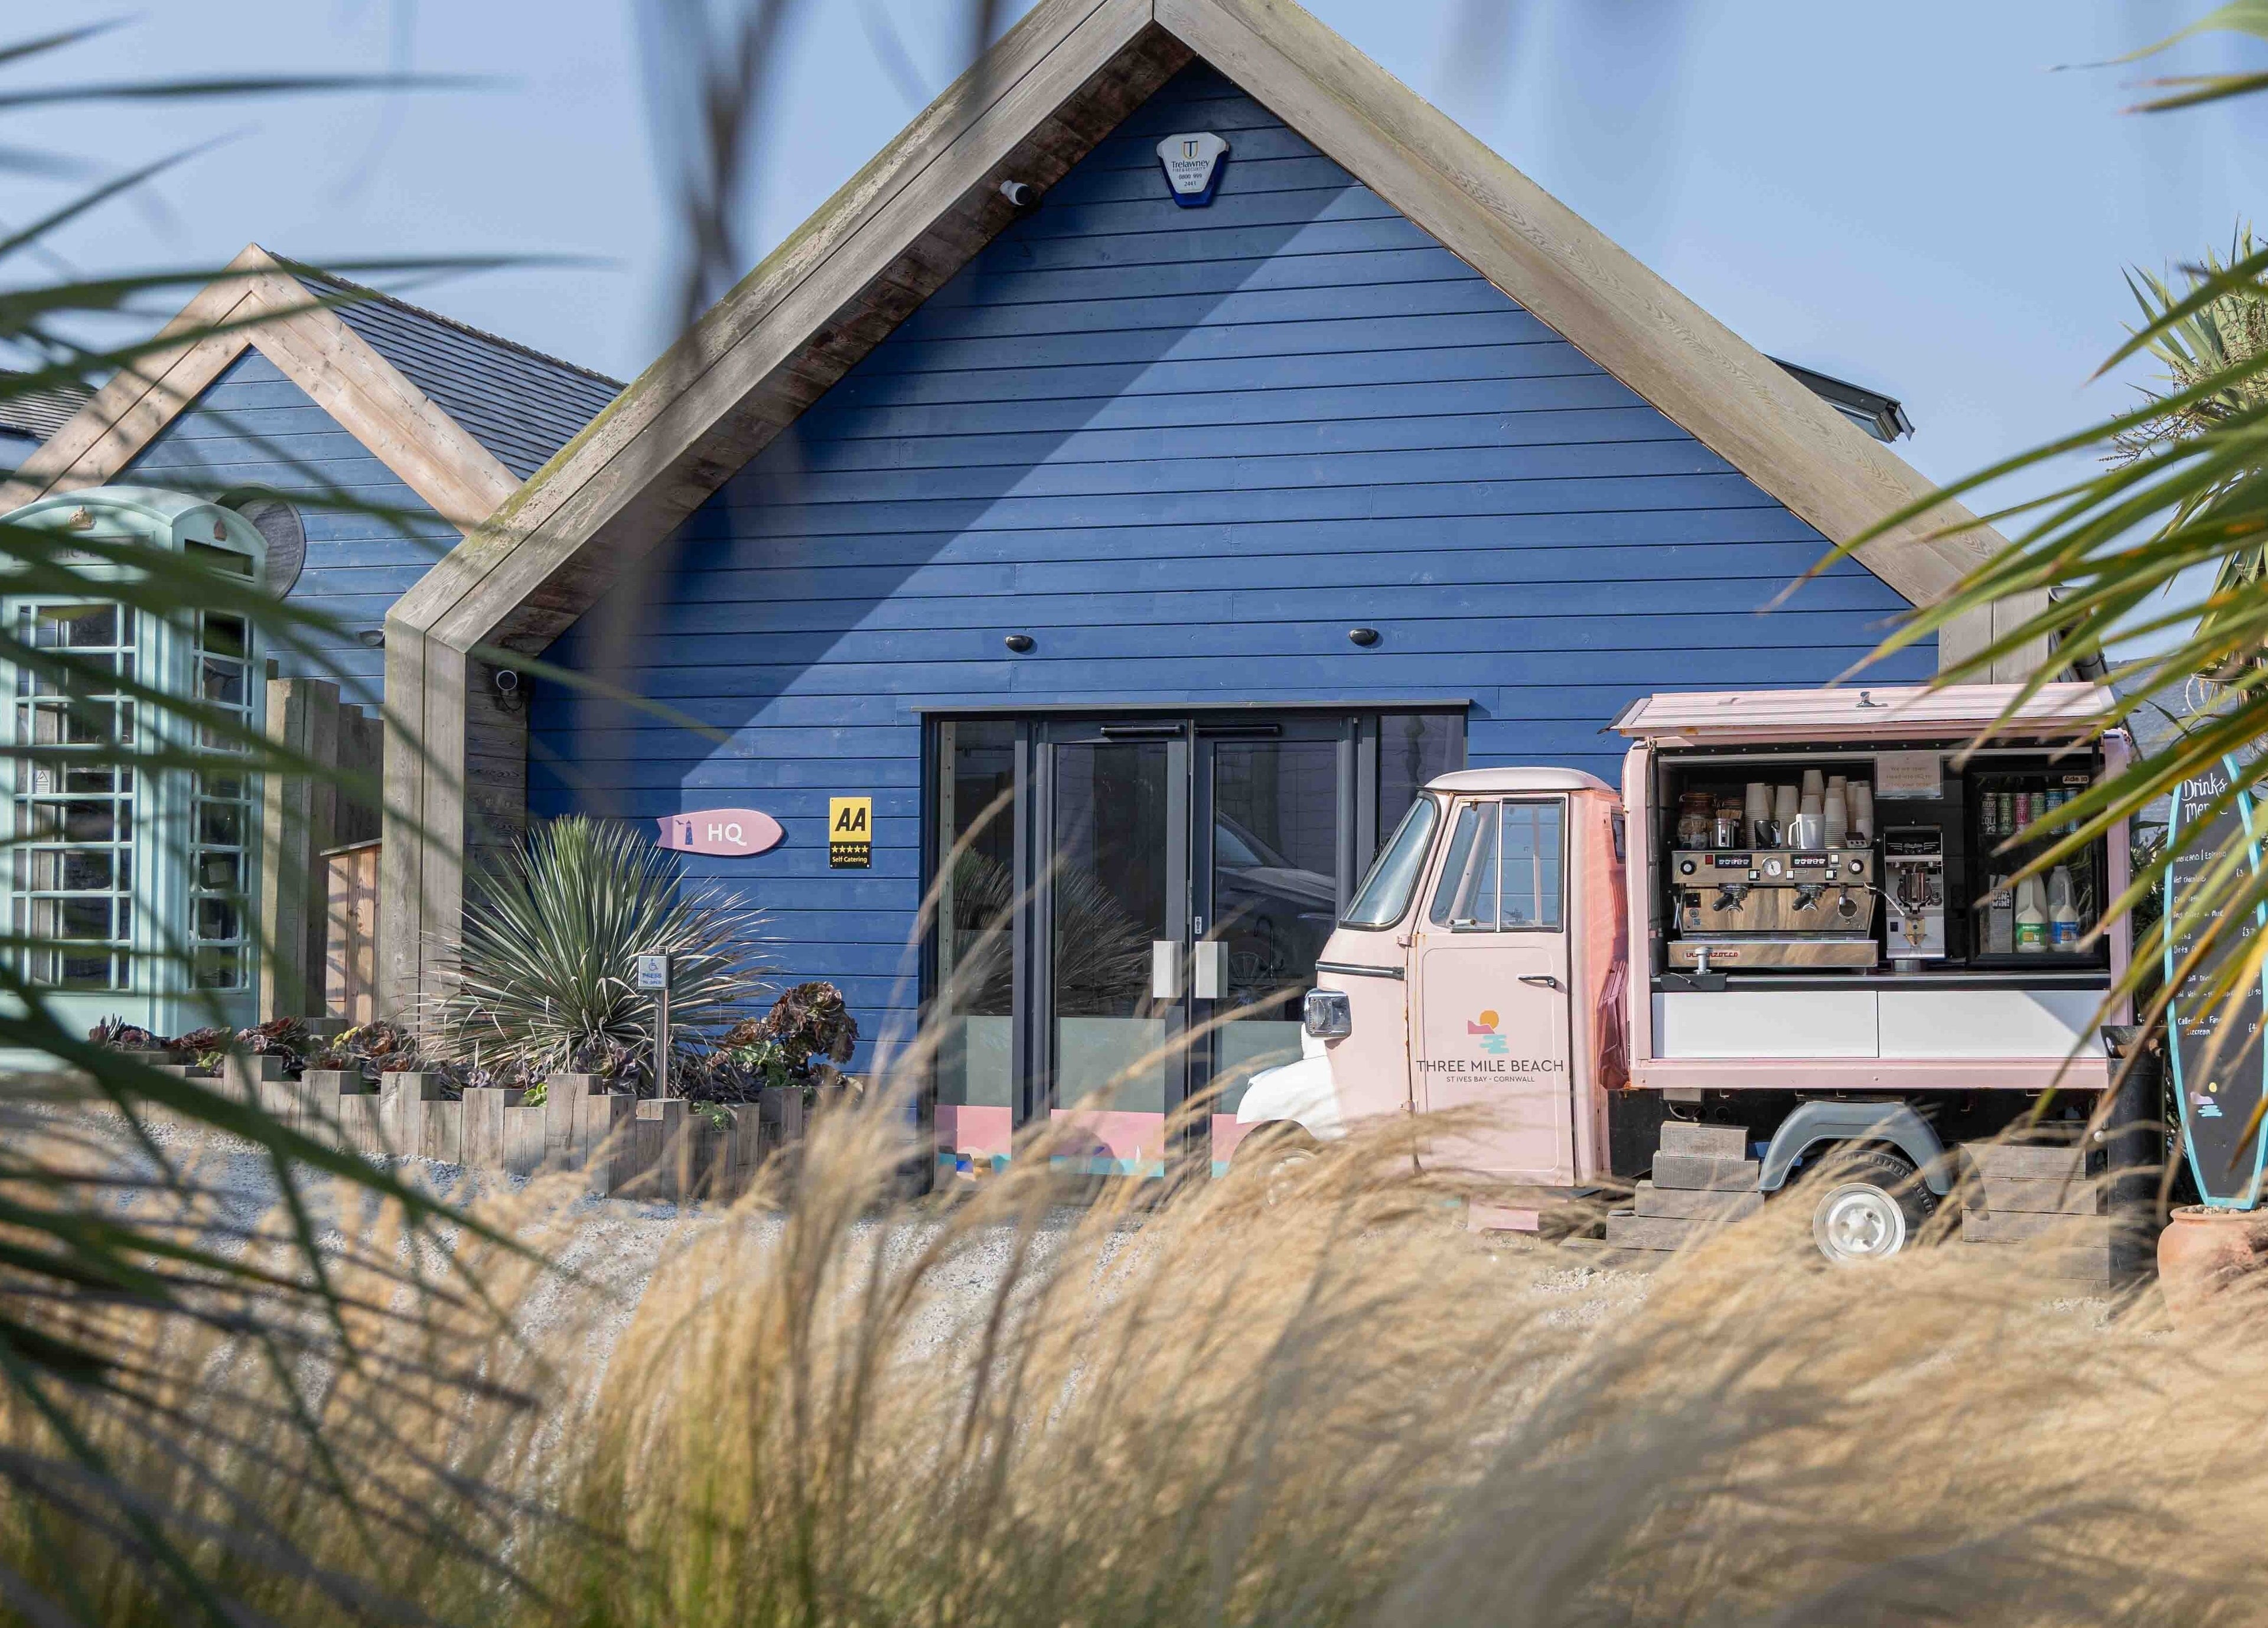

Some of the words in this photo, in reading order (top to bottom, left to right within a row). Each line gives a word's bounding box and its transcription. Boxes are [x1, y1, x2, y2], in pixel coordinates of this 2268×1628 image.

[2181, 772, 2228, 801] Drinks
[835, 808, 865, 831] AA
[708, 823, 747, 846] HQ
[844, 856, 868, 864] Catering
[1416, 1060, 1465, 1072] THREE
[1471, 1060, 1506, 1072] MILE
[1511, 1060, 1564, 1072] BEACH
